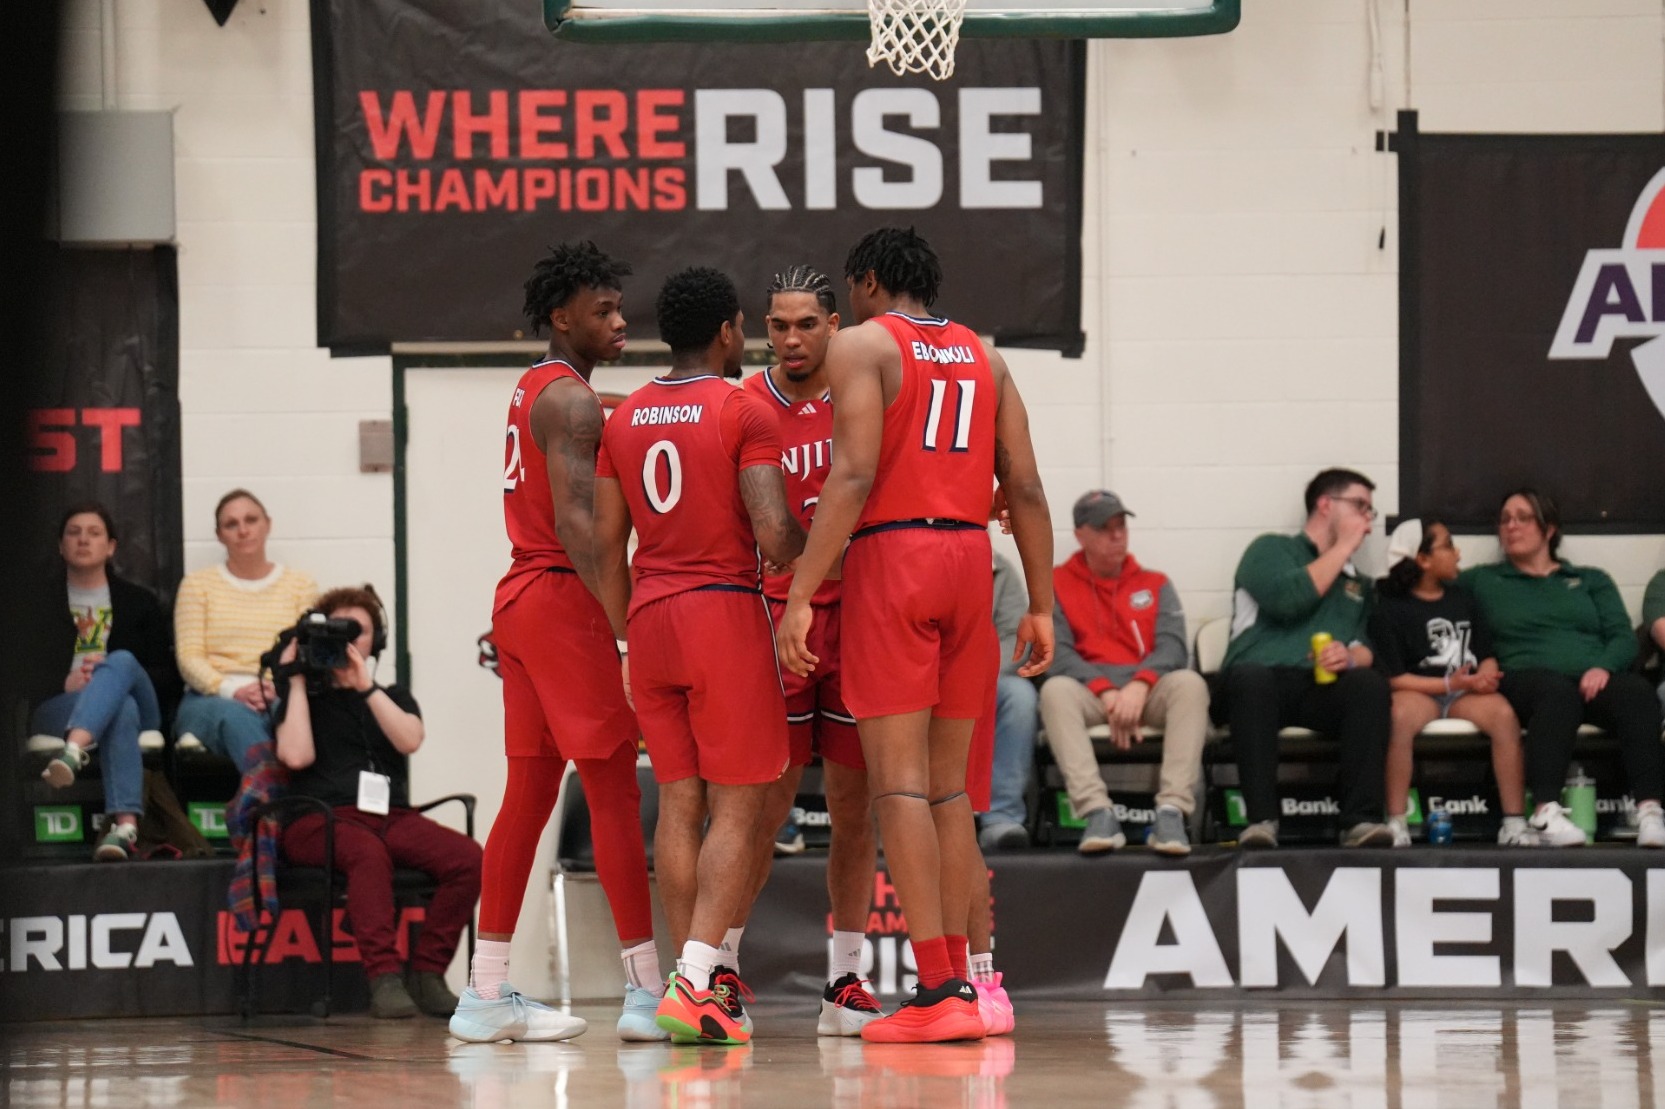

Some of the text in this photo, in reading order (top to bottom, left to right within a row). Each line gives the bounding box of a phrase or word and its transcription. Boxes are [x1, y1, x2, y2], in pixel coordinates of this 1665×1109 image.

[359, 89, 685, 160] WHERE
[694, 87, 1043, 211] RISE
[359, 167, 687, 212] CHAMPIONS
[631, 404, 703, 427] ROBINSON
[922, 378, 976, 453] 11
[642, 439, 682, 515] 0
[39, 811, 78, 835] TD
[1281, 796, 1341, 817] Bank
[0, 912, 194, 972] RICA
